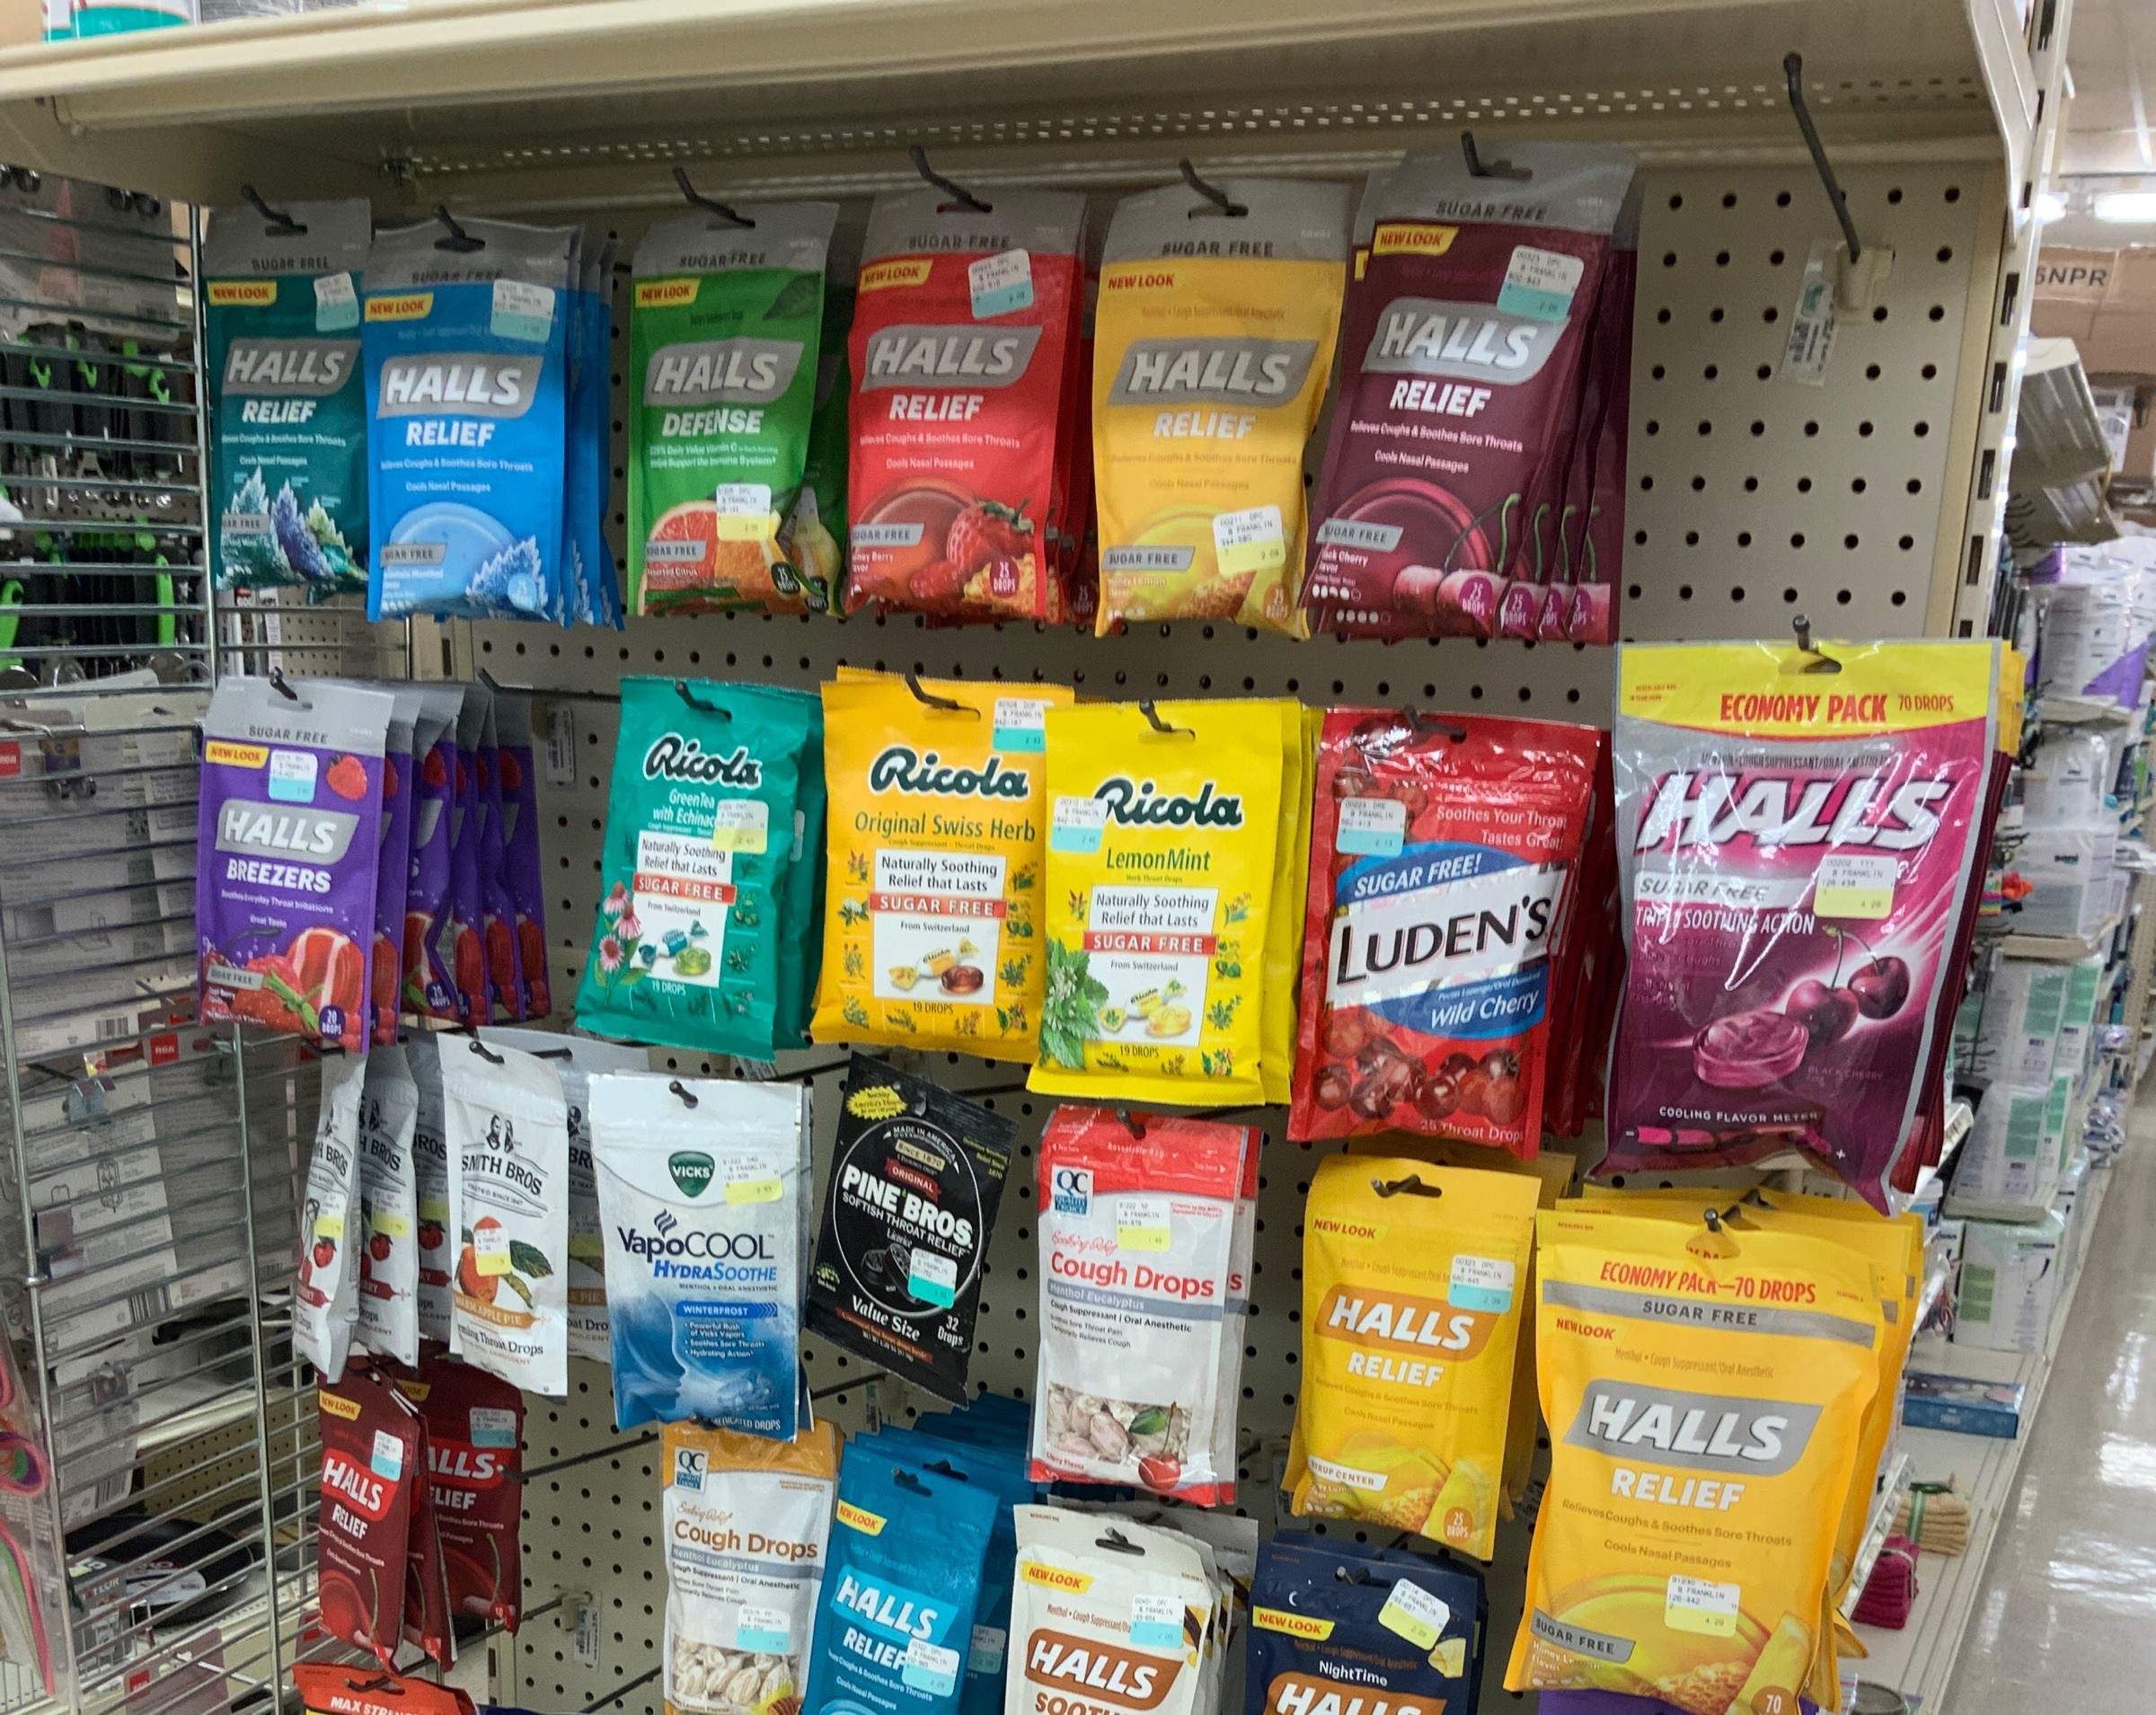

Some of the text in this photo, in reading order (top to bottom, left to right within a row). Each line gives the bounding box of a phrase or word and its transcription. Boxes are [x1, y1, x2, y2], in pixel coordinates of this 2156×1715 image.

[1229, 242, 1273, 256] FREE
[1381, 233, 1443, 247] NEW LOOK
[731, 252, 765, 265] FREE
[864, 265, 921, 285] NEW LOOK
[1109, 274, 1174, 289] NEW LOOK
[214, 287, 269, 301] NEW LOOK
[641, 285, 691, 301] NEW LOOK
[369, 300, 425, 316] NEW LOOK
[1378, 313, 1538, 369] HALLS
[226, 348, 345, 385] HALLS
[870, 337, 1020, 377] HALLS
[652, 352, 778, 393] HALLS
[1129, 350, 1291, 394] HALLS
[386, 366, 522, 406] HALLS
[889, 395, 984, 421] RELIEF
[1390, 381, 1491, 417] RELIEF
[243, 401, 316, 423] RELIEF
[662, 410, 764, 436] DEFENSE
[406, 420, 495, 446] RELIEF
[1154, 411, 1256, 439] RELIEF
[1720, 694, 1954, 723] ECONOMY PACK 70 DROPS
[249, 725, 329, 745] SUGAR FREE
[210, 747, 261, 763] NEW LOOK
[645, 737, 761, 786] Ricola
[870, 747, 1029, 798] Ricola
[669, 789, 715, 809] Green Tea
[1094, 778, 1242, 826] Ricola
[653, 807, 674, 822] with
[1437, 806, 1567, 829] Soothes Your Throat
[1637, 774, 1953, 850] HALLS
[224, 810, 337, 854] HALLS
[855, 811, 1036, 843] Original Swiss Herb
[1481, 829, 1523, 847] Tastes
[642, 838, 726, 863] Naturally Soothing
[1106, 848, 1211, 872] LemonMint
[226, 859, 332, 893] BREEZERS
[644, 854, 717, 878] Relief that Lasts
[881, 855, 997, 879] Naturally Soothing
[1354, 853, 1482, 898] SUGAR FREE!
[639, 878, 723, 901] SUGAR FREE
[888, 874, 987, 892] Relief that Lasts
[647, 901, 662, 913] From
[879, 896, 994, 916] SUGAR FREE
[1097, 893, 1208, 913] Naturally Soothing
[901, 921, 969, 934] From Switzerland
[1101, 911, 1197, 928] Relief that Lasts
[1683, 910, 1757, 932] SOOTHING
[1760, 913, 1815, 934] ACTION
[1093, 934, 1202, 954] SUGAR FREE
[1337, 895, 1551, 986] LUDEN'S
[1110, 959, 1178, 972] From Switzerland
[661, 983, 685, 996] DROPS
[924, 1002, 953, 1015] DROPS
[1431, 989, 1538, 1030] Wild Cherry
[1132, 1046, 1159, 1059] DROPS
[1659, 1106, 1767, 1124] COOLING FLAVOR
[507, 1163, 543, 1196] BROS
[672, 1165, 710, 1178] VICKS
[892, 1166, 934, 1193] ORIGINAL
[1057, 1169, 1088, 1195] QC
[843, 1163, 903, 1213] PINE
[843, 1191, 967, 1259] SOFTISH THROAT RELIEF
[1313, 1219, 1375, 1239] NEW LOOK
[617, 1225, 774, 1263] VapoCOOL
[1051, 1252, 1215, 1297] Cough Drops
[1600, 1261, 1816, 1304] ECONOMY DROPS
[684, 1305, 748, 1316] WINTERFROST
[1087, 1290, 1144, 1311] Eucalyptus
[853, 1295, 890, 1327] Value
[892, 1316, 921, 1341] Size
[946, 1314, 959, 1331] 32
[1329, 1295, 1474, 1351] HALLS
[1642, 1301, 1757, 1327] SUGAR FREE
[938, 1326, 964, 1347] Drops
[1557, 1318, 1616, 1340] NEW LOOK
[509, 1338, 544, 1356] Drops
[1348, 1351, 1444, 1388] RELIEF
[755, 1419, 781, 1431] DROPS
[1589, 1393, 1788, 1463] HALLS
[678, 1450, 705, 1472] QC
[323, 1457, 384, 1512] HALLS
[1336, 1470, 1374, 1487] CENTER
[1611, 1467, 1746, 1512] RELIEF
[332, 1503, 368, 1540] RELIEF
[854, 1514, 879, 1530] LOOK
[1562, 1498, 1604, 1520] Relieves
[1605, 1510, 1649, 1532] Coughs
[1662, 1520, 1710, 1537] Soothes
[1714, 1526, 1743, 1540] Sore
[1746, 1532, 1792, 1549] Throats
[675, 1521, 817, 1562] Cough Drops
[1604, 1539, 1672, 1561] Cools Nasal
[1028, 1568, 1082, 1590] NEW LOOK
[1687, 1585, 1725, 1601] FRANKLIN
[836, 1575, 938, 1640] HALLS
[1259, 1613, 1322, 1635] NEW LOOK
[1535, 1617, 1615, 1656] SUGAR FREE
[1029, 1638, 1159, 1699] HALLS
[1320, 1660, 1388, 1687] NightTime
[331, 1695, 361, 1711] MAX
[1766, 1694, 1782, 1714] 70
